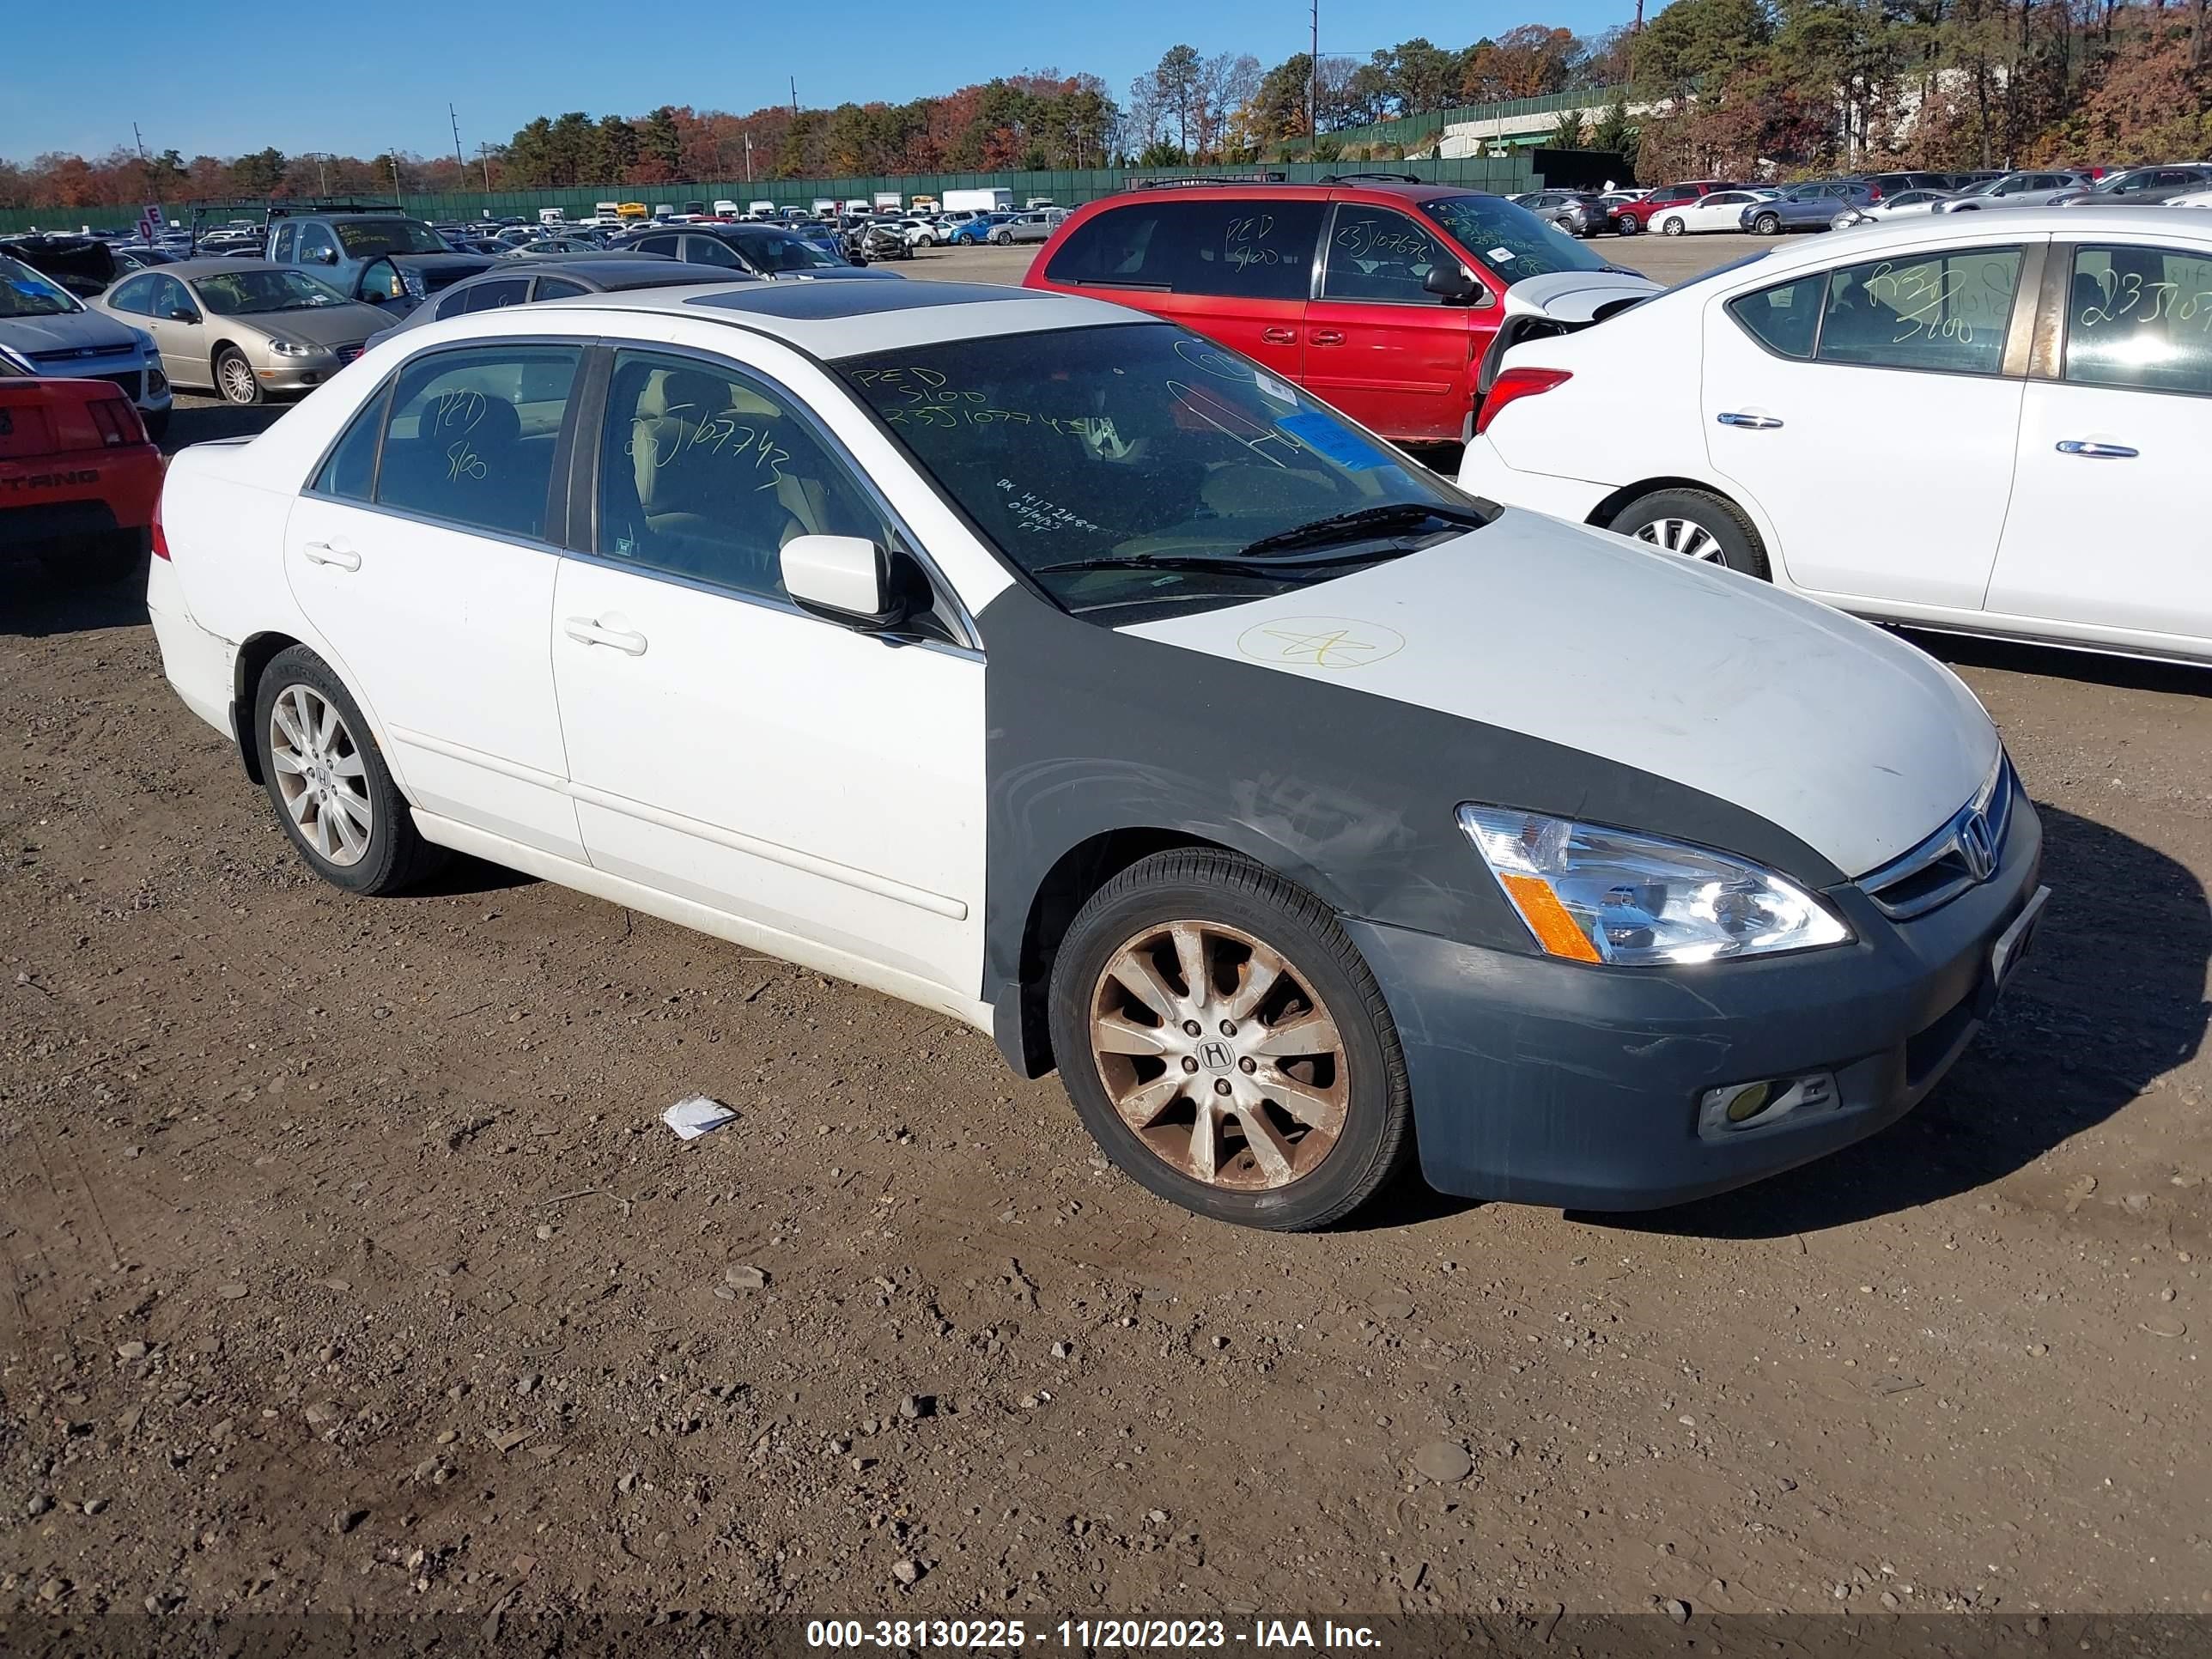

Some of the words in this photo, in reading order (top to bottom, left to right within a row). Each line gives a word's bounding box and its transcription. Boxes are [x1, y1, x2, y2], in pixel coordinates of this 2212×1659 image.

[148, 208, 161, 223] E
[836, 202, 842, 215] F
[140, 221, 152, 238] D
